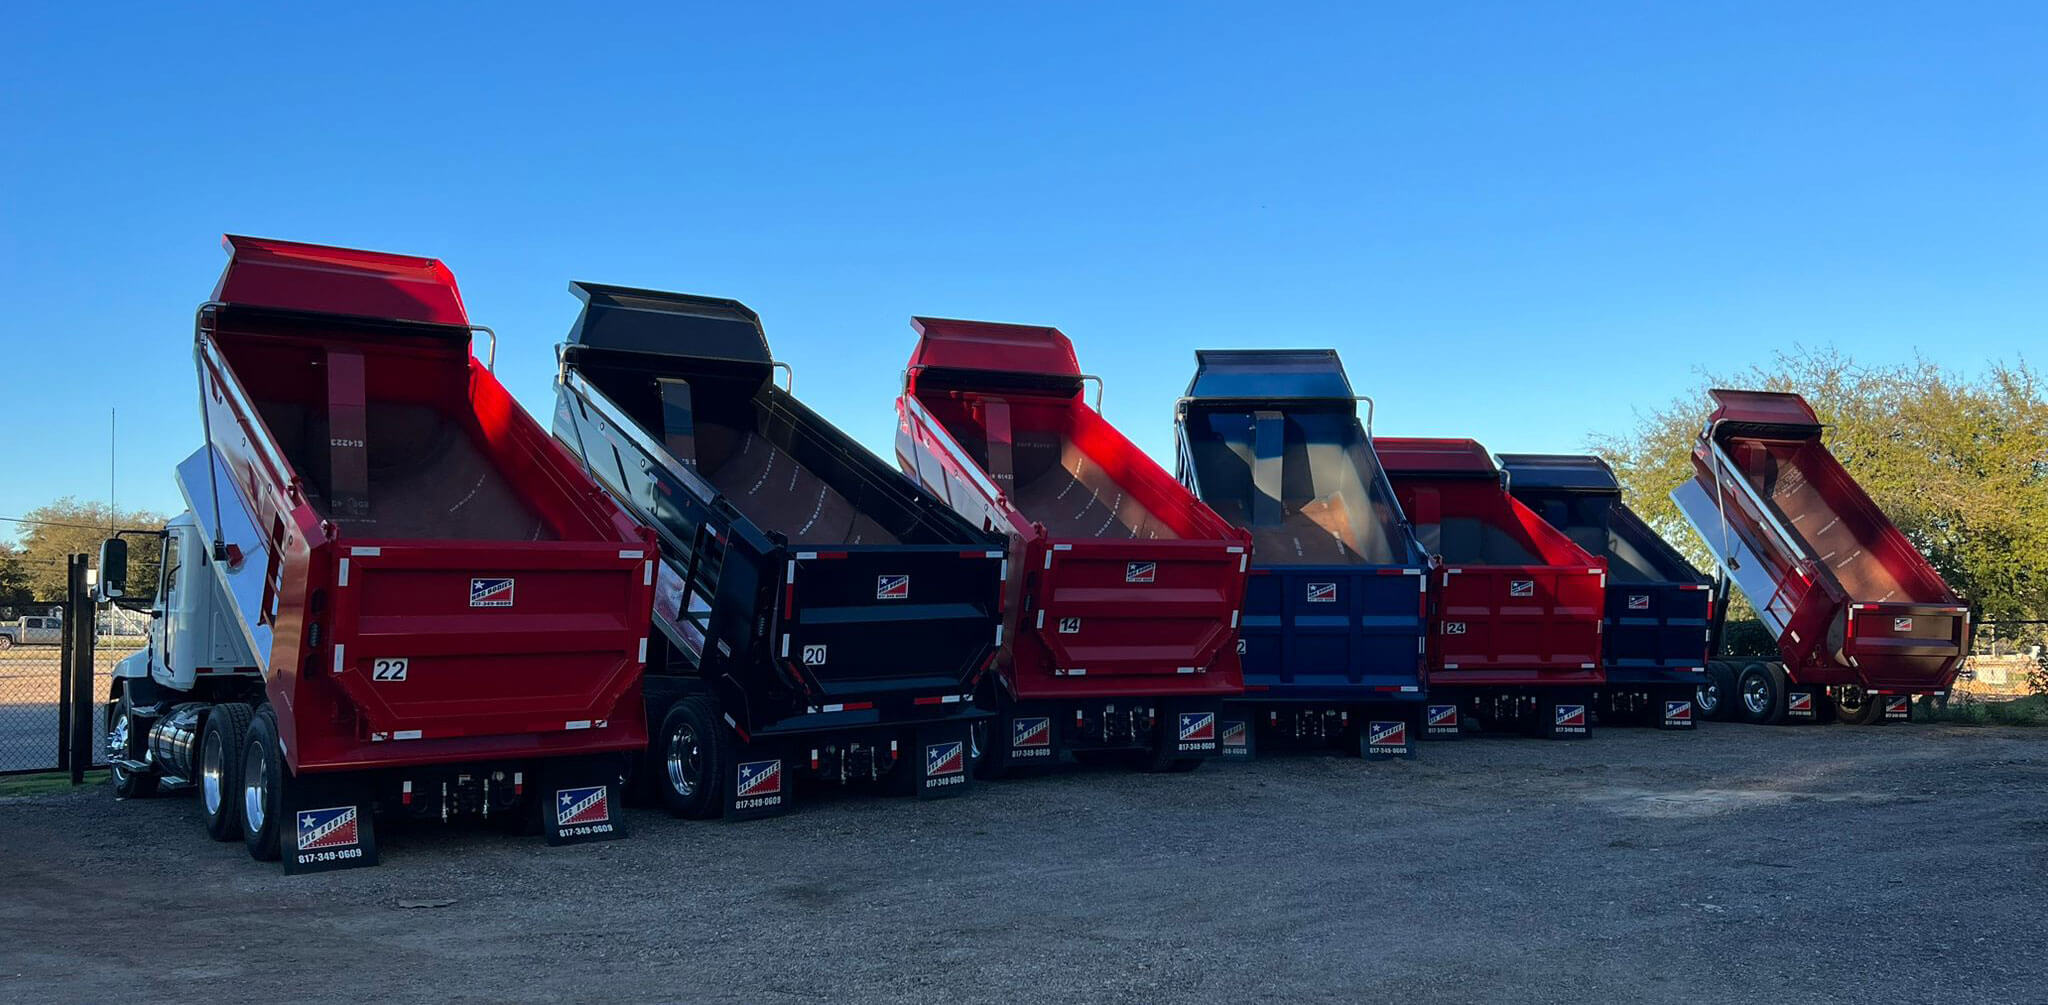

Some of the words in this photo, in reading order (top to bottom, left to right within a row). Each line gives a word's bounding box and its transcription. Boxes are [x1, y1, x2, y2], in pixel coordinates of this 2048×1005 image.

[1061, 618, 1078, 631] 14
[1449, 623, 1464, 633] 24
[806, 648, 824, 663] 20
[376, 661, 405, 680] 22
[736, 796, 781, 809] 817-349-0609
[321, 809, 355, 833] BODIES
[559, 824, 613, 837] 817-349-0609
[298, 848, 362, 864] 817-349-0609
